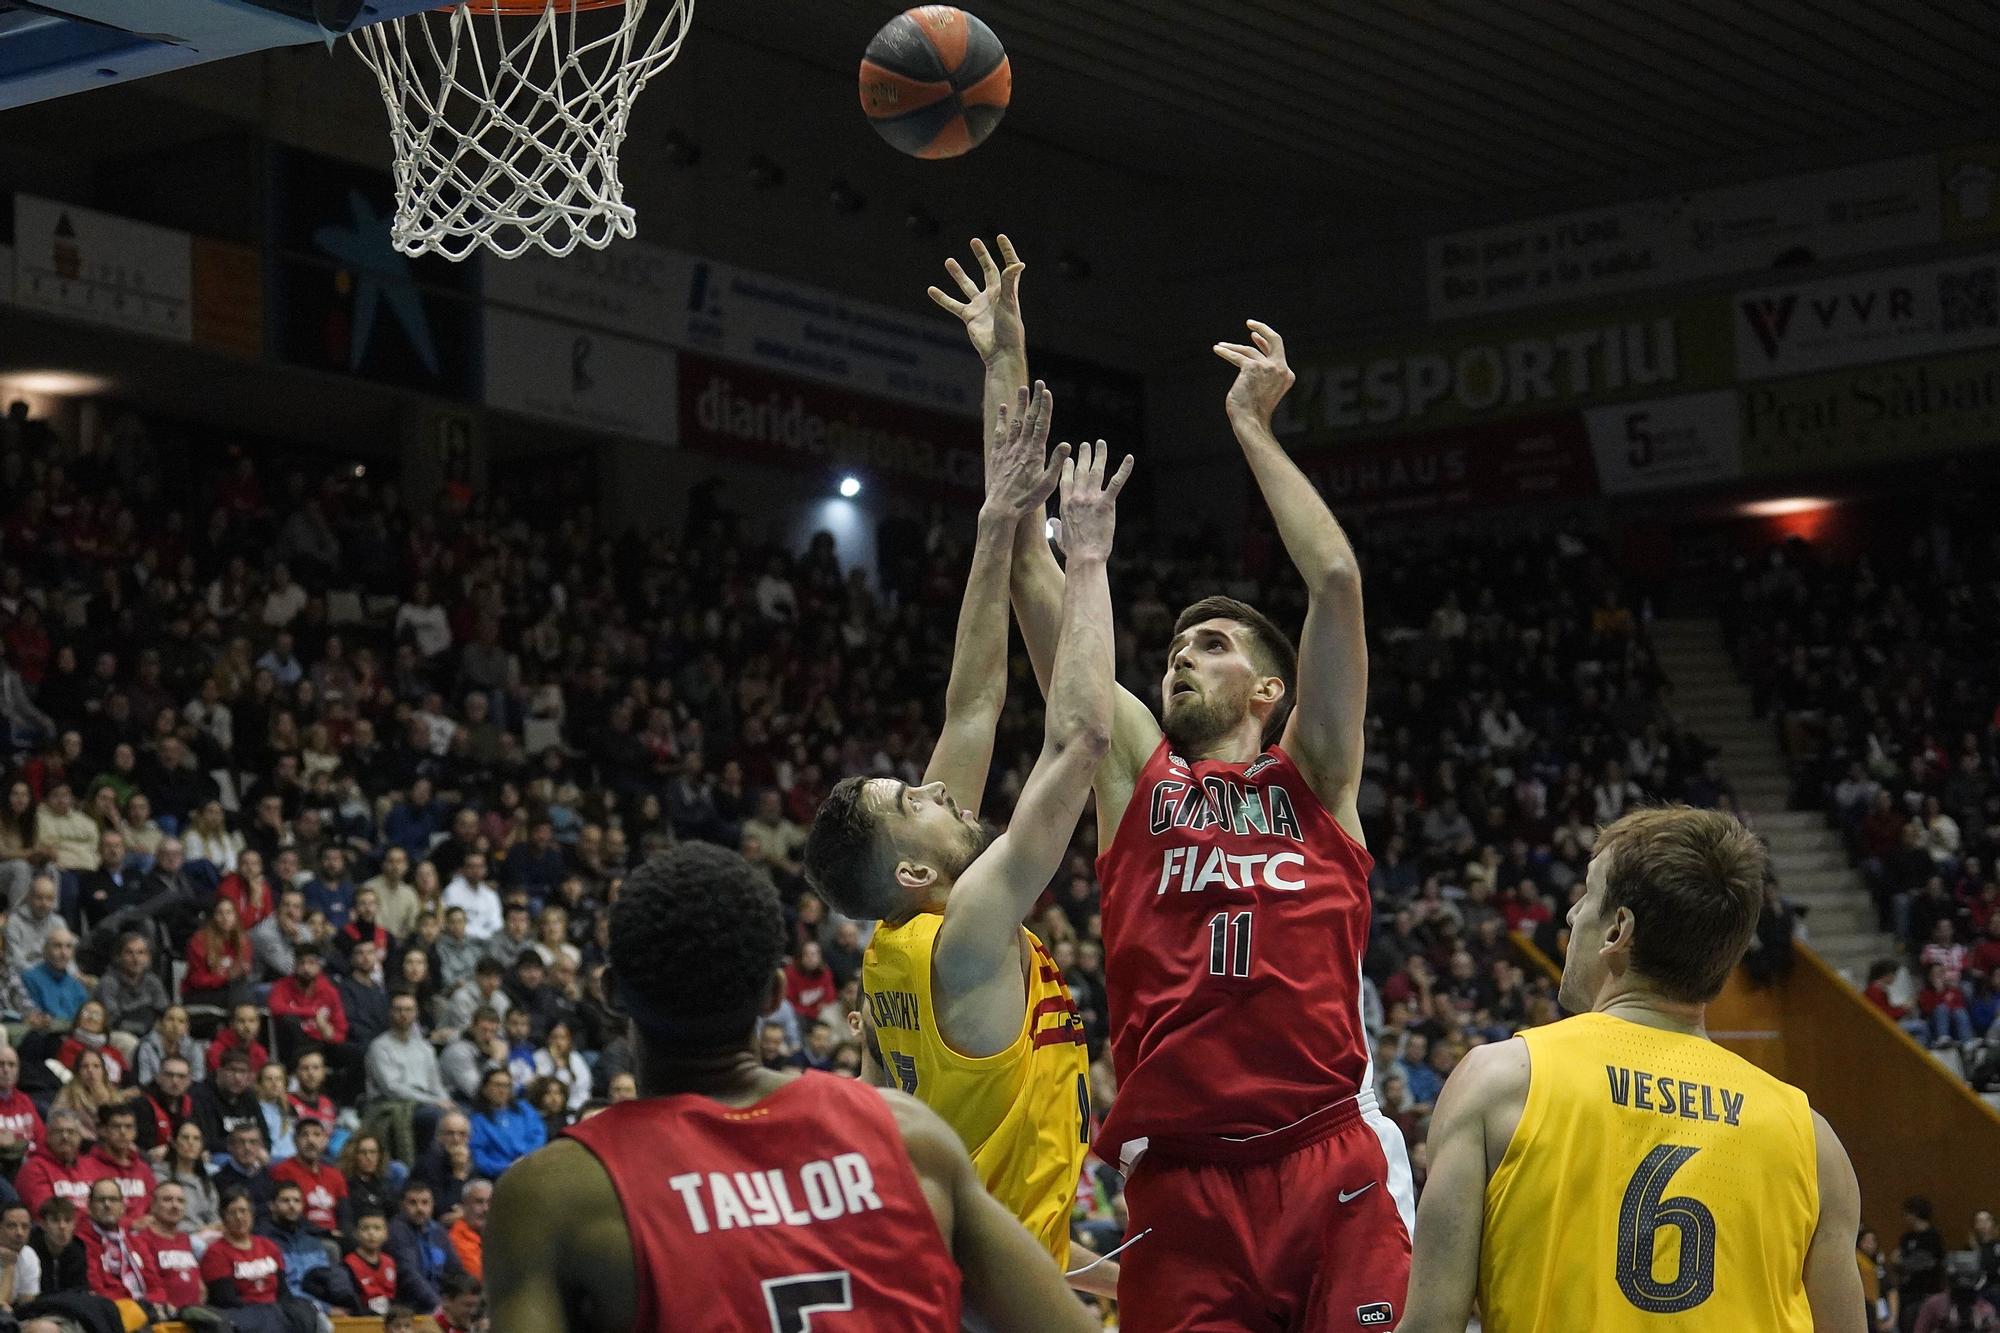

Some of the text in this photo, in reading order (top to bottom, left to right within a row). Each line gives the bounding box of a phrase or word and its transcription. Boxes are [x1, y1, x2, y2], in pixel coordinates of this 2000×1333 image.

[1271, 317, 1679, 435] L'ESPORTIU
[1306, 449, 1467, 496] AUHAUS
[1157, 846, 1306, 895] FIATC
[1208, 911, 1253, 979] 11
[1606, 1064, 1744, 1126] VESELY
[669, 1152, 883, 1234] TAYLOR
[1615, 1143, 1717, 1313] 6
[1361, 1311, 1386, 1322] acb
